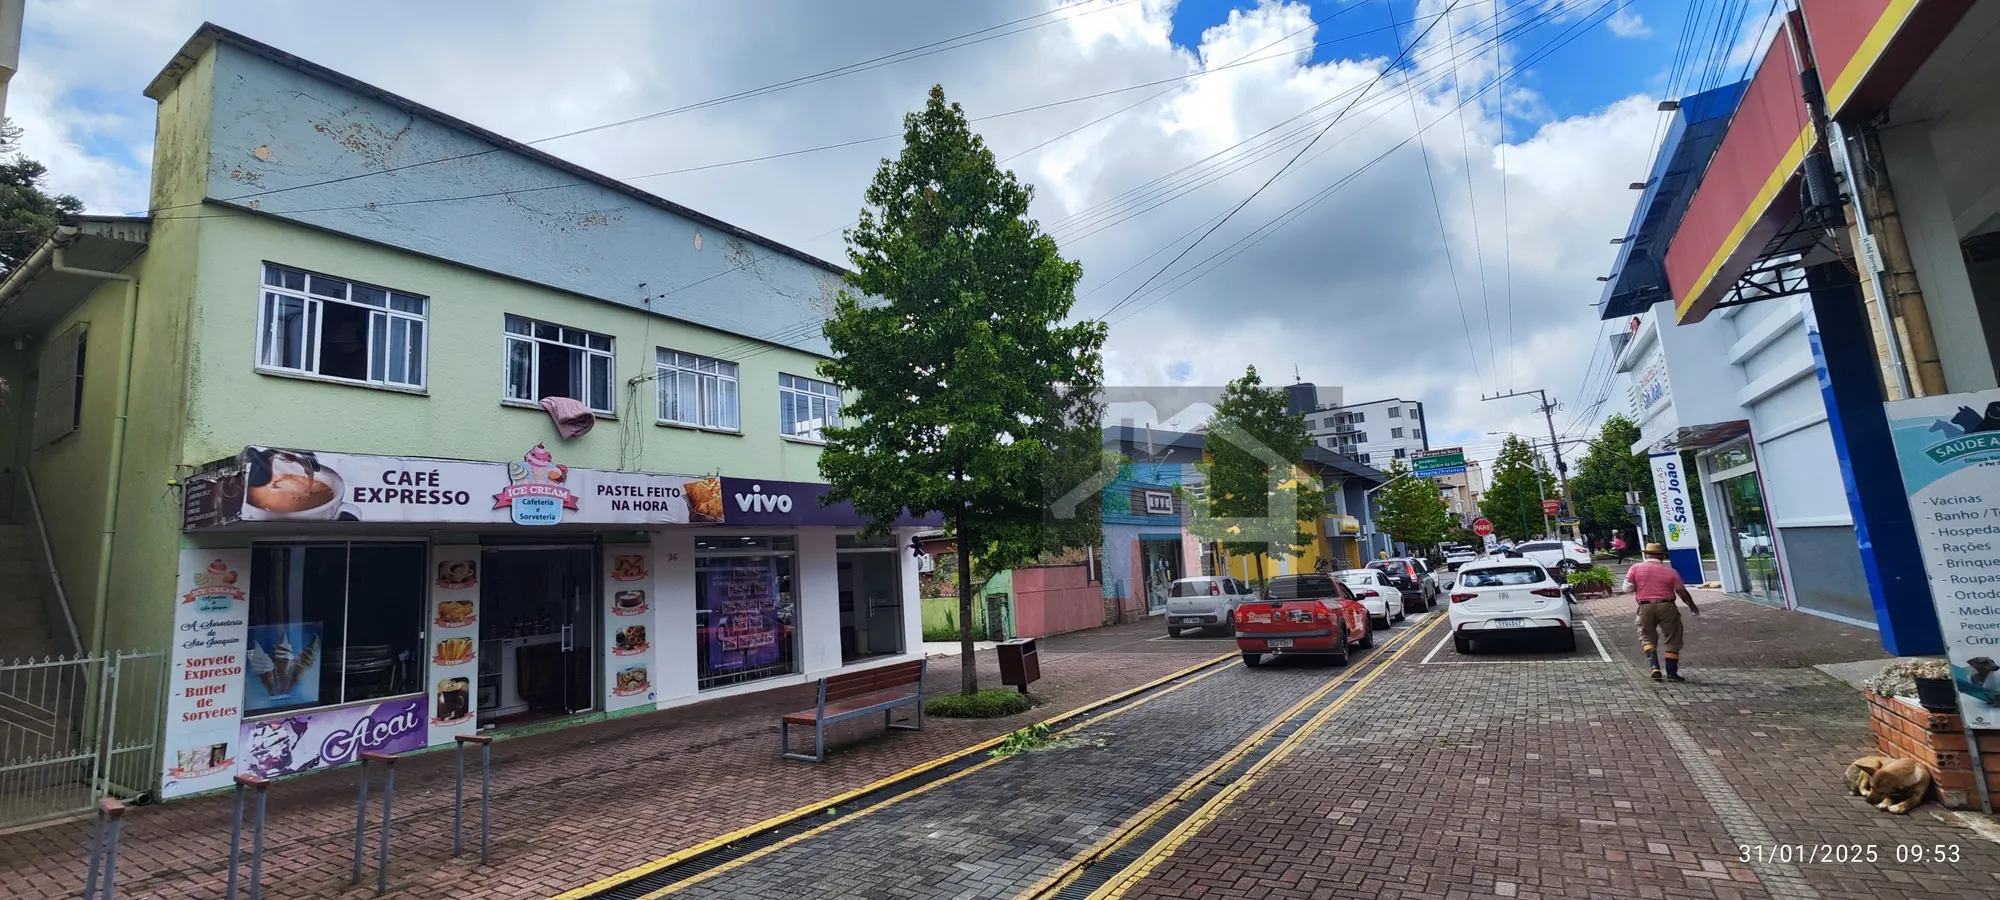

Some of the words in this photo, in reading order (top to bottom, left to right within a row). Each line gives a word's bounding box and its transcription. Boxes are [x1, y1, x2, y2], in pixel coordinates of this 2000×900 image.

[1936, 438, 1986, 458] SAÚDE
[382, 469, 440, 487] CAFÉ
[1664, 462, 1681, 494] João
[353, 487, 470, 505] EXPRESSO
[507, 486, 528, 497] ICE
[529, 486, 568, 499] CREAM
[597, 484, 644, 497] PASTEL
[647, 486, 681, 498] FEITO
[734, 484, 793, 513] vivo
[1929, 496, 1982, 506] Vacinas
[612, 500, 630, 510] NA
[633, 501, 668, 512] HORA
[1672, 498, 1687, 524] São
[1935, 510, 1979, 521] Banho
[1990, 508, 2000, 517] T
[1939, 524, 2000, 537] Hospeda
[1942, 542, 1991, 553] Rações
[1946, 559, 2000, 568] Brinque
[1950, 575, 2000, 584] Roupas
[181, 620, 200, 632] A
[199, 619, 243, 630] Sorveteria
[181, 638, 204, 649] São
[206, 637, 239, 648] Joaquim
[186, 654, 236, 668] Sorvete
[184, 666, 242, 680] Expresso
[185, 683, 226, 698] Buffet
[196, 698, 213, 708] de
[182, 707, 238, 722] Sorvetes
[322, 702, 418, 760] Açaí
